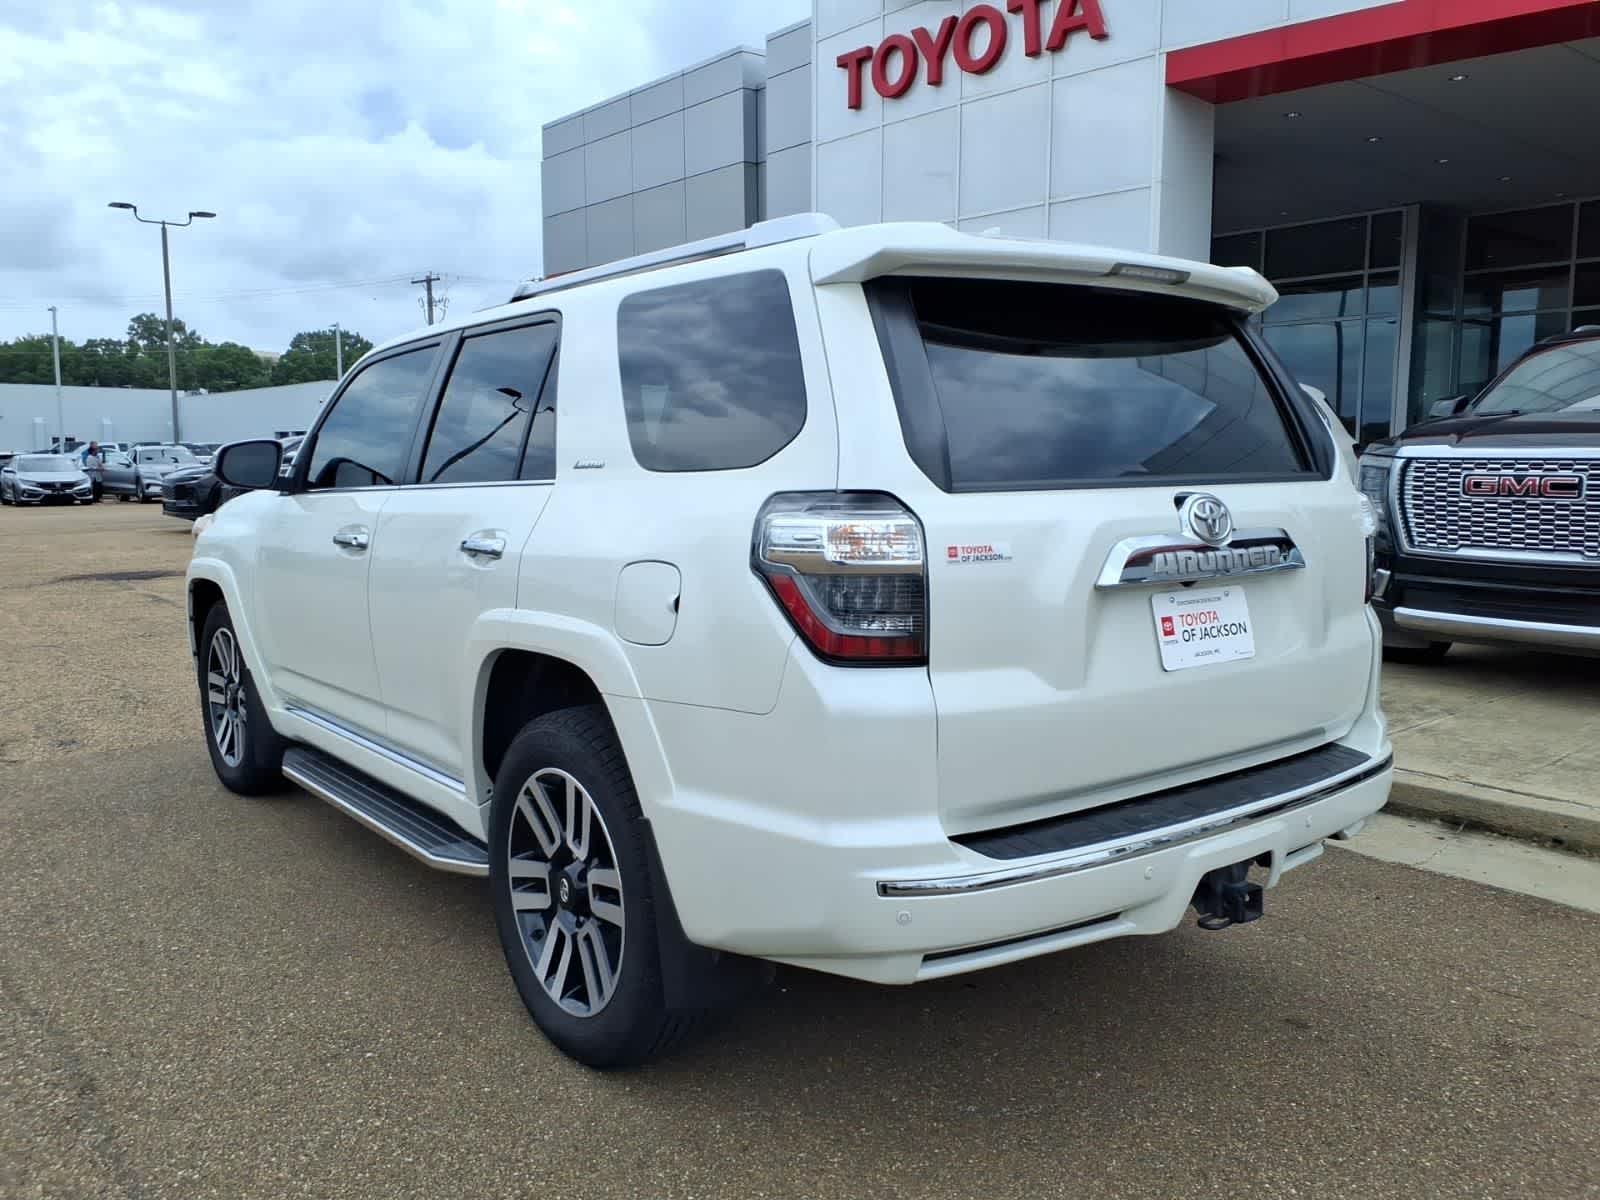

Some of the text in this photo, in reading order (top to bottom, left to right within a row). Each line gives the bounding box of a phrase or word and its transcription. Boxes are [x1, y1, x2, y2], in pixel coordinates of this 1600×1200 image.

[836, 0, 1108, 110] TOYOTA
[1464, 475, 1579, 498] GMC
[961, 546, 993, 555] TOYOTA
[972, 553, 1003, 562] JACKSON
[1178, 611, 1220, 627] TOYOTA
[1182, 629, 1197, 643] OF
[1199, 621, 1248, 641] JACKSON
